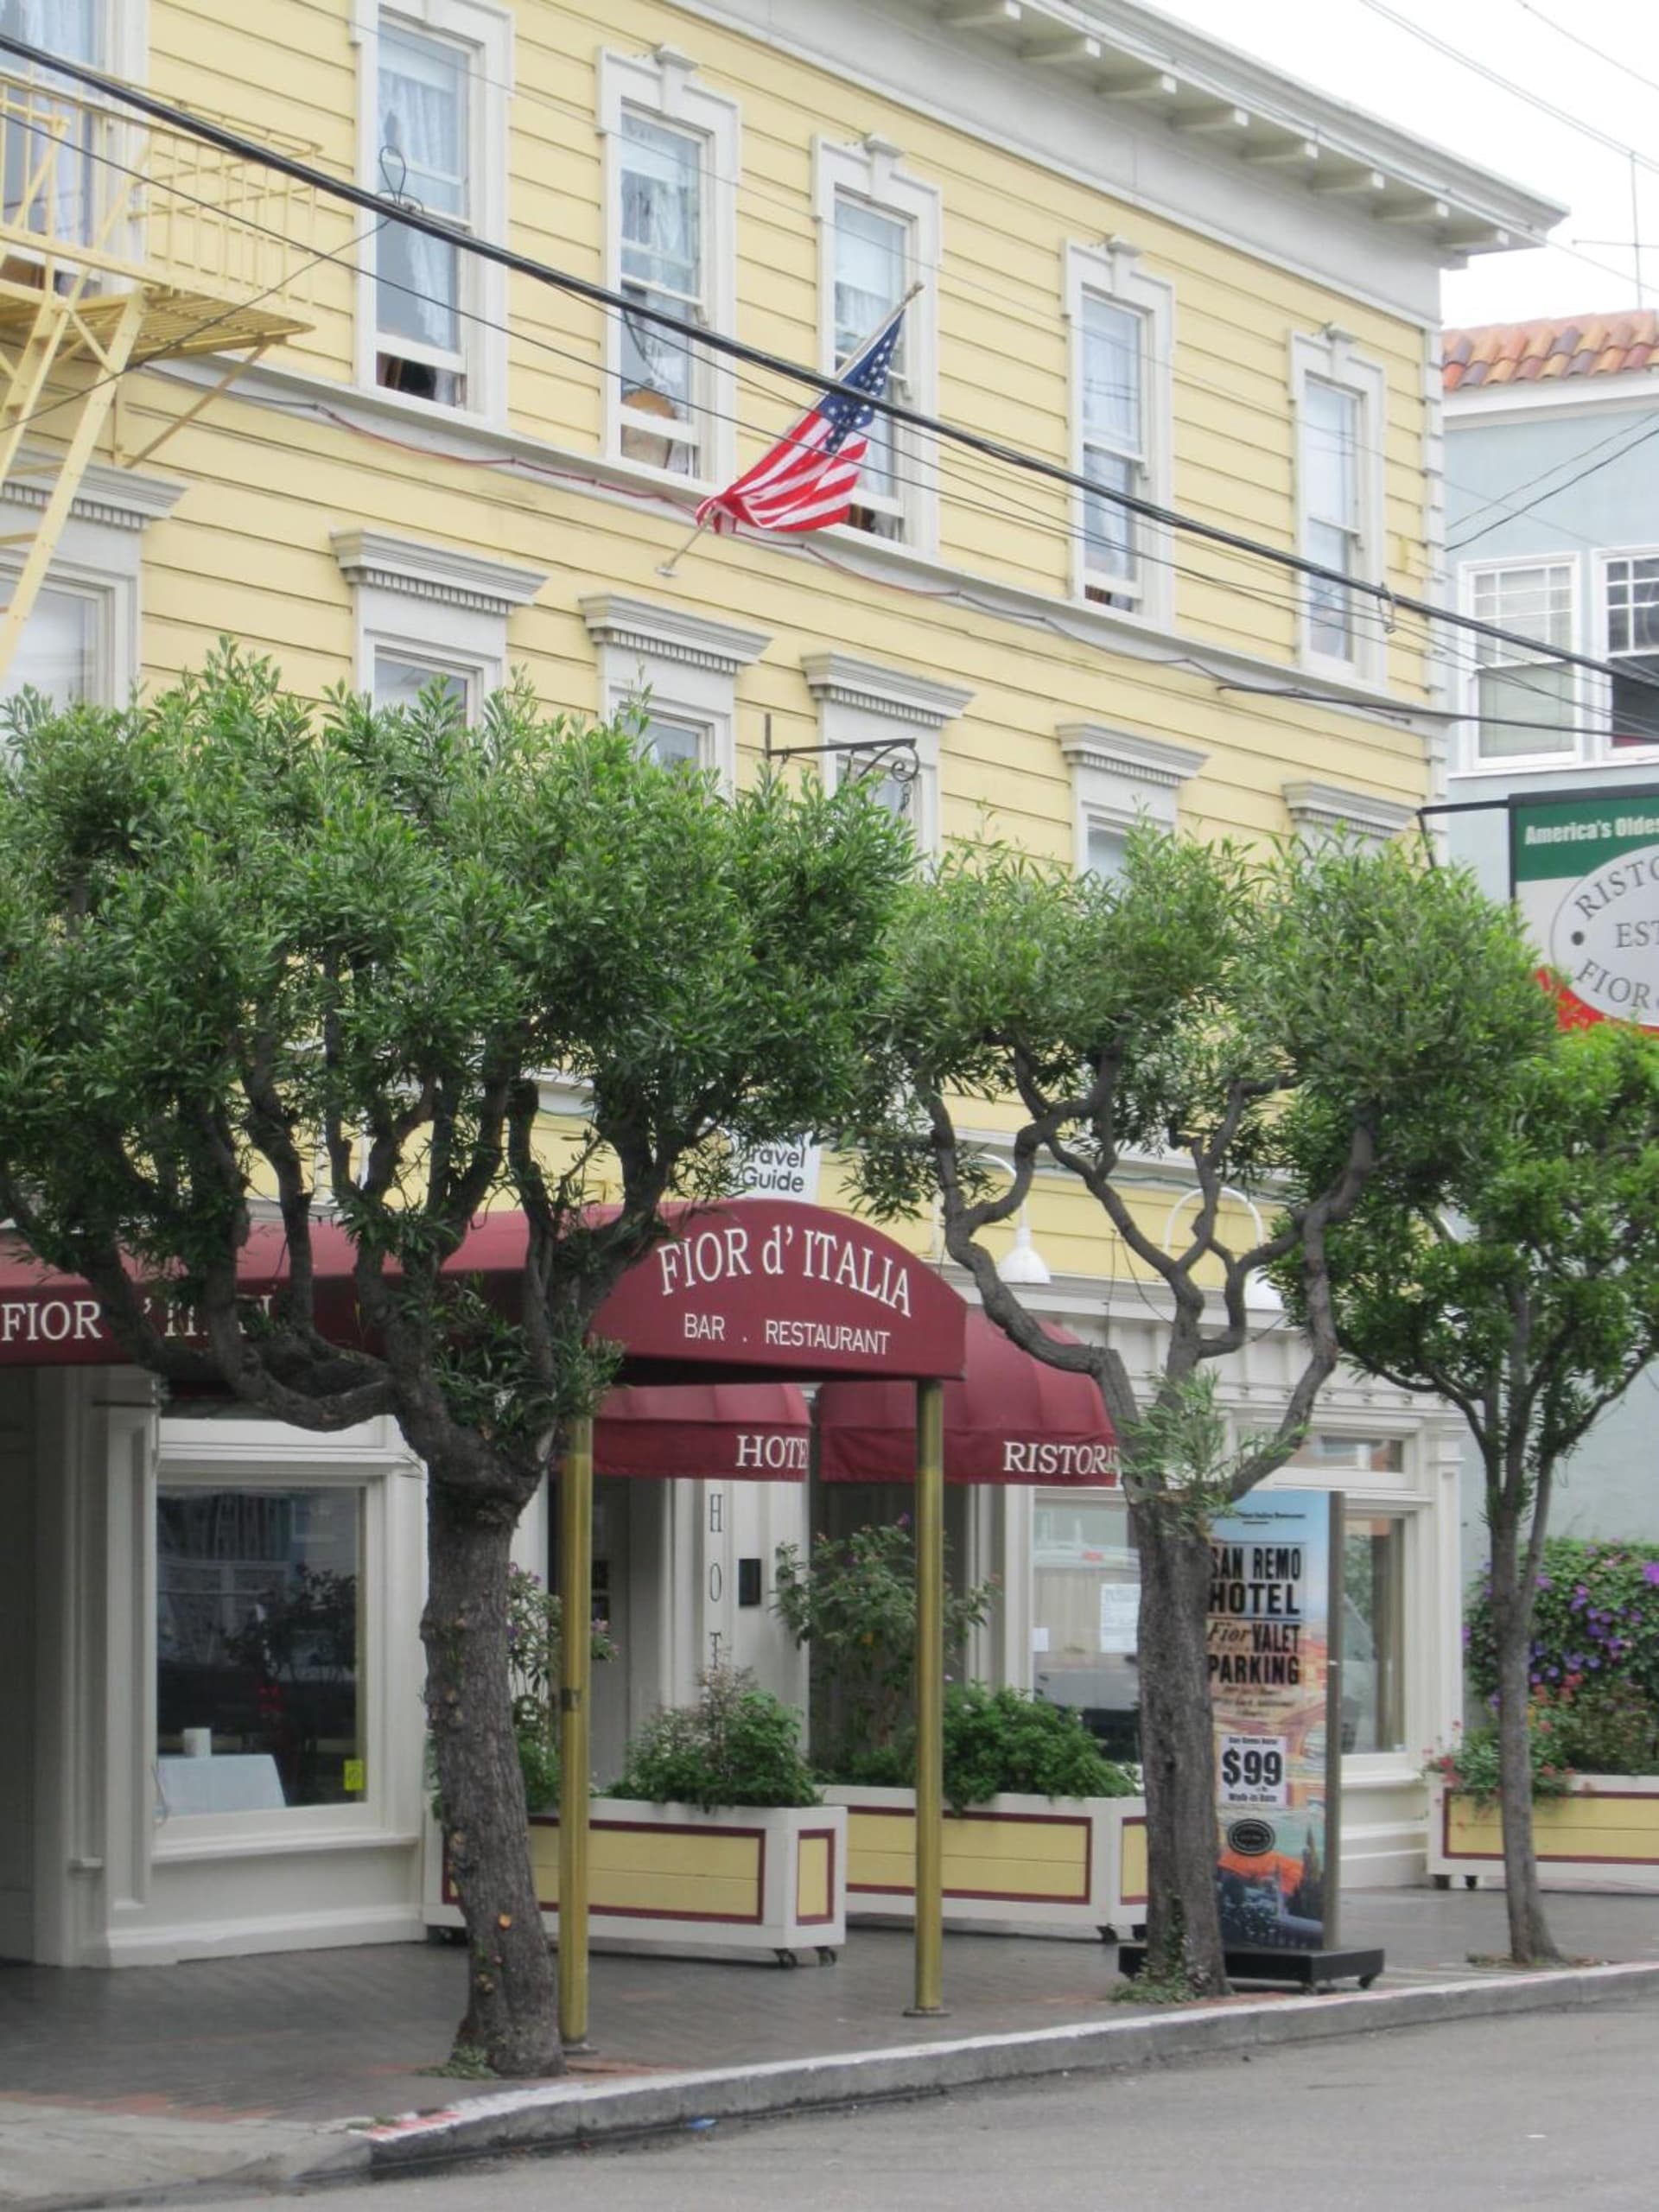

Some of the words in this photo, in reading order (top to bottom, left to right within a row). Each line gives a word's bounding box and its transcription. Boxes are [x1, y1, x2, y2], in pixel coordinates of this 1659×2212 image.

[1524, 819, 1611, 845] America's
[1575, 958, 1651, 1009] FIOR
[745, 1133, 805, 1168] ravel
[743, 1166, 804, 1192] Guide
[657, 1227, 752, 1296] FIOR
[1, 1300, 103, 1341] FIOR
[684, 1313, 725, 1341] BAR
[766, 1319, 891, 1356] RESTAURANT
[1253, 1547, 1300, 1581] REMO
[1210, 1582, 1300, 1615] HOTEL
[1252, 1624, 1300, 1654] VALET
[1207, 1654, 1300, 1685] PARKING
[1223, 1747, 1281, 1789] $99
